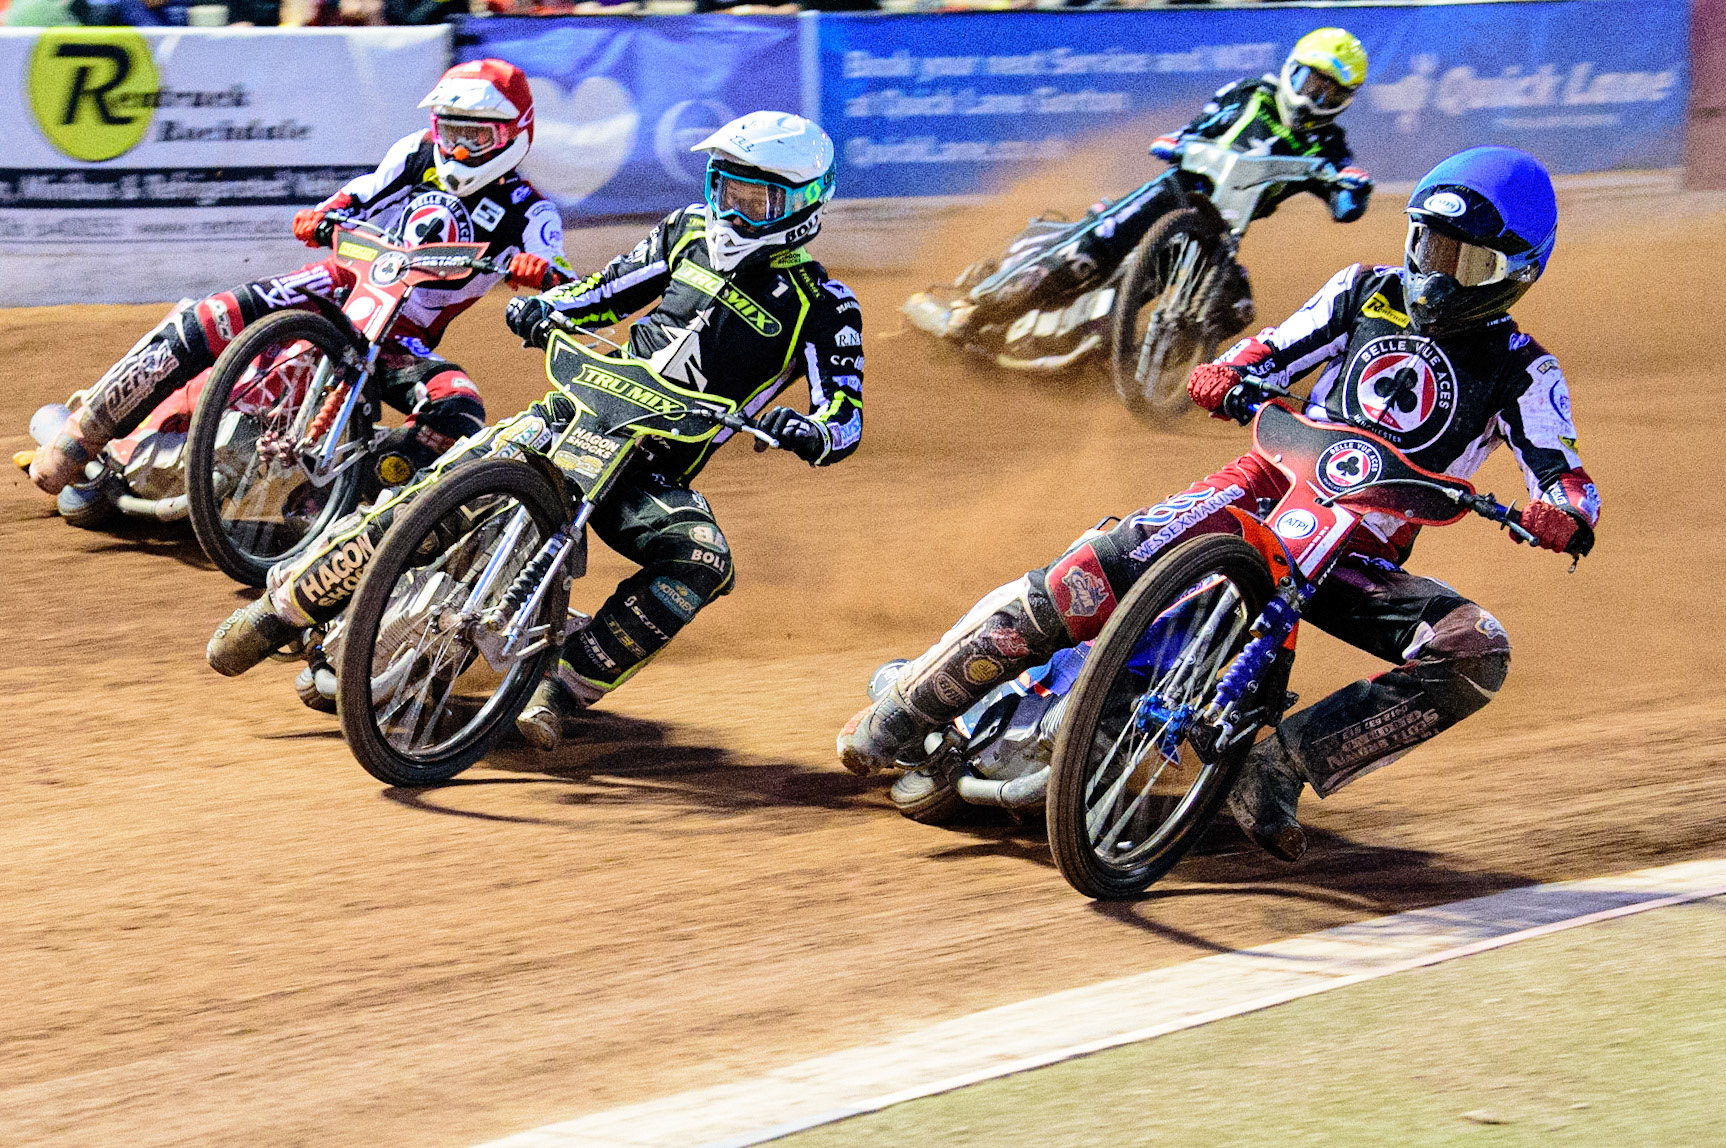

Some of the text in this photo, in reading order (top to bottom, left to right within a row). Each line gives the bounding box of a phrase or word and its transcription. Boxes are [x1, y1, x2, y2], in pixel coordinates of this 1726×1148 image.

[772, 281, 790, 298] 1
[727, 289, 775, 331] MIX
[584, 369, 680, 414] TRU MIX
[1360, 340, 1452, 410] BELLE VUE ACES
[566, 435, 612, 460] SHOCKS
[572, 427, 620, 453] HAGON
[1283, 517, 1309, 532] ATPI
[300, 531, 376, 603] HAGON
